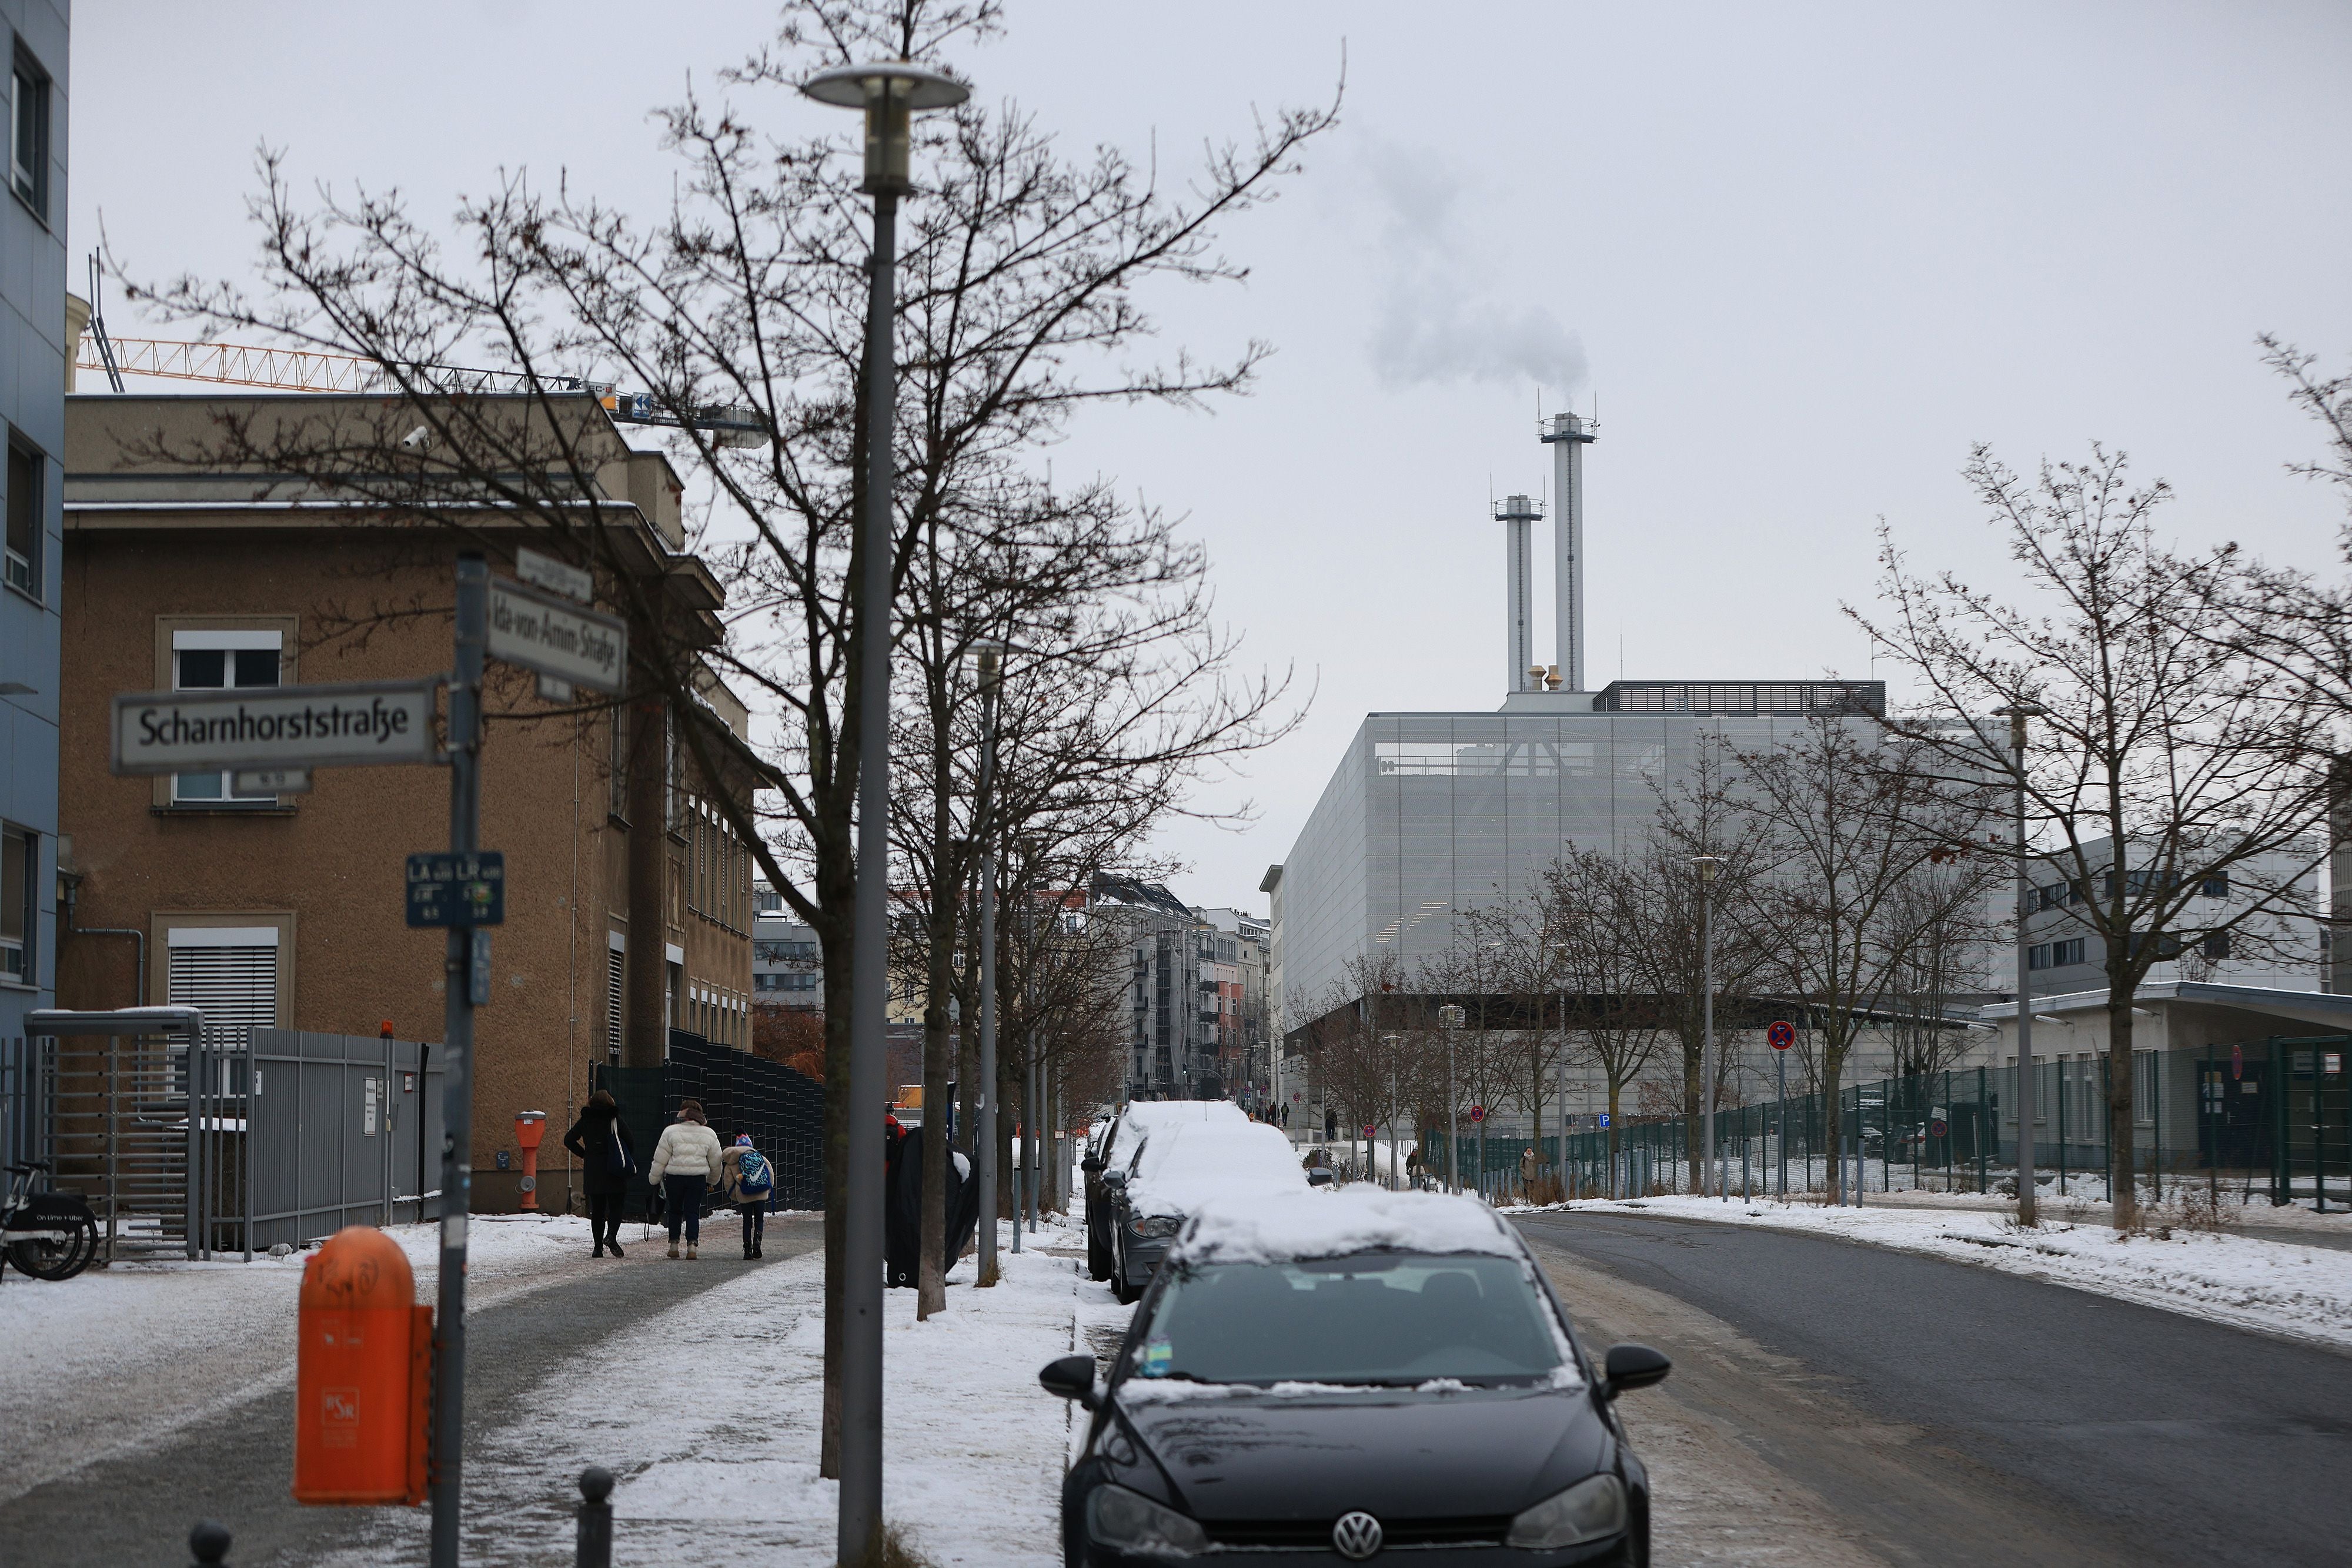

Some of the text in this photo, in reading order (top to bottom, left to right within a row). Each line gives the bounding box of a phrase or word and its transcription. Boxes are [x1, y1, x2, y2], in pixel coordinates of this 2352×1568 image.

[139, 697, 408, 746] Scharnhorststraße
[1602, 1115, 1609, 1125] P
[1334, 1512, 1382, 1559] VW
